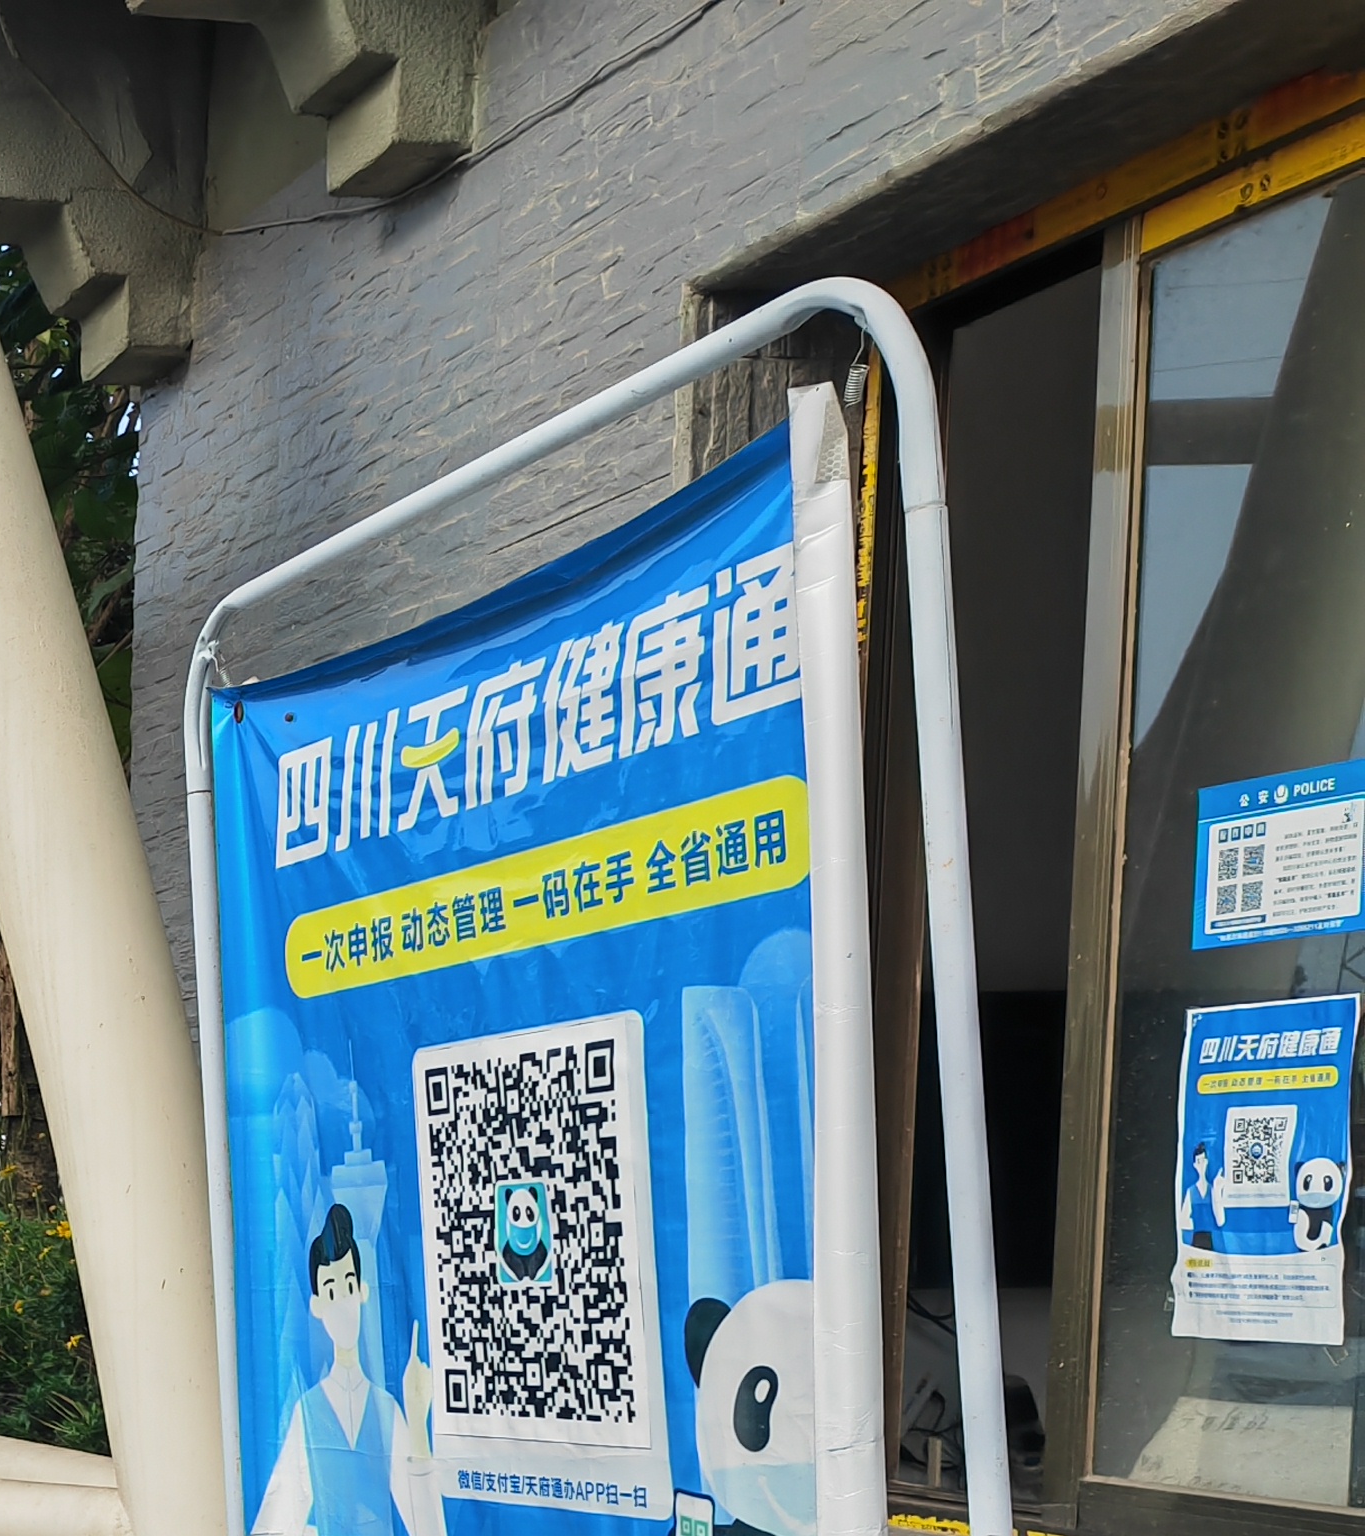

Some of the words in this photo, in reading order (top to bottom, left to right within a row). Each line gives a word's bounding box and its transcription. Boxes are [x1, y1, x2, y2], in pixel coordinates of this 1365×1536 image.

[274, 541, 801, 869] 四川天府健康通
[1293, 777, 1336, 797] POLICE
[301, 914, 395, 972] 一次申报
[400, 885, 507, 955] 动态管理
[512, 852, 636, 919] 一码在手
[645, 808, 788, 894] 全省通用
[1198, 1026, 1343, 1064] 四川天府健康通
[457, 1469, 648, 1509] 微信/支付宝/天府通办APP扫一扫
